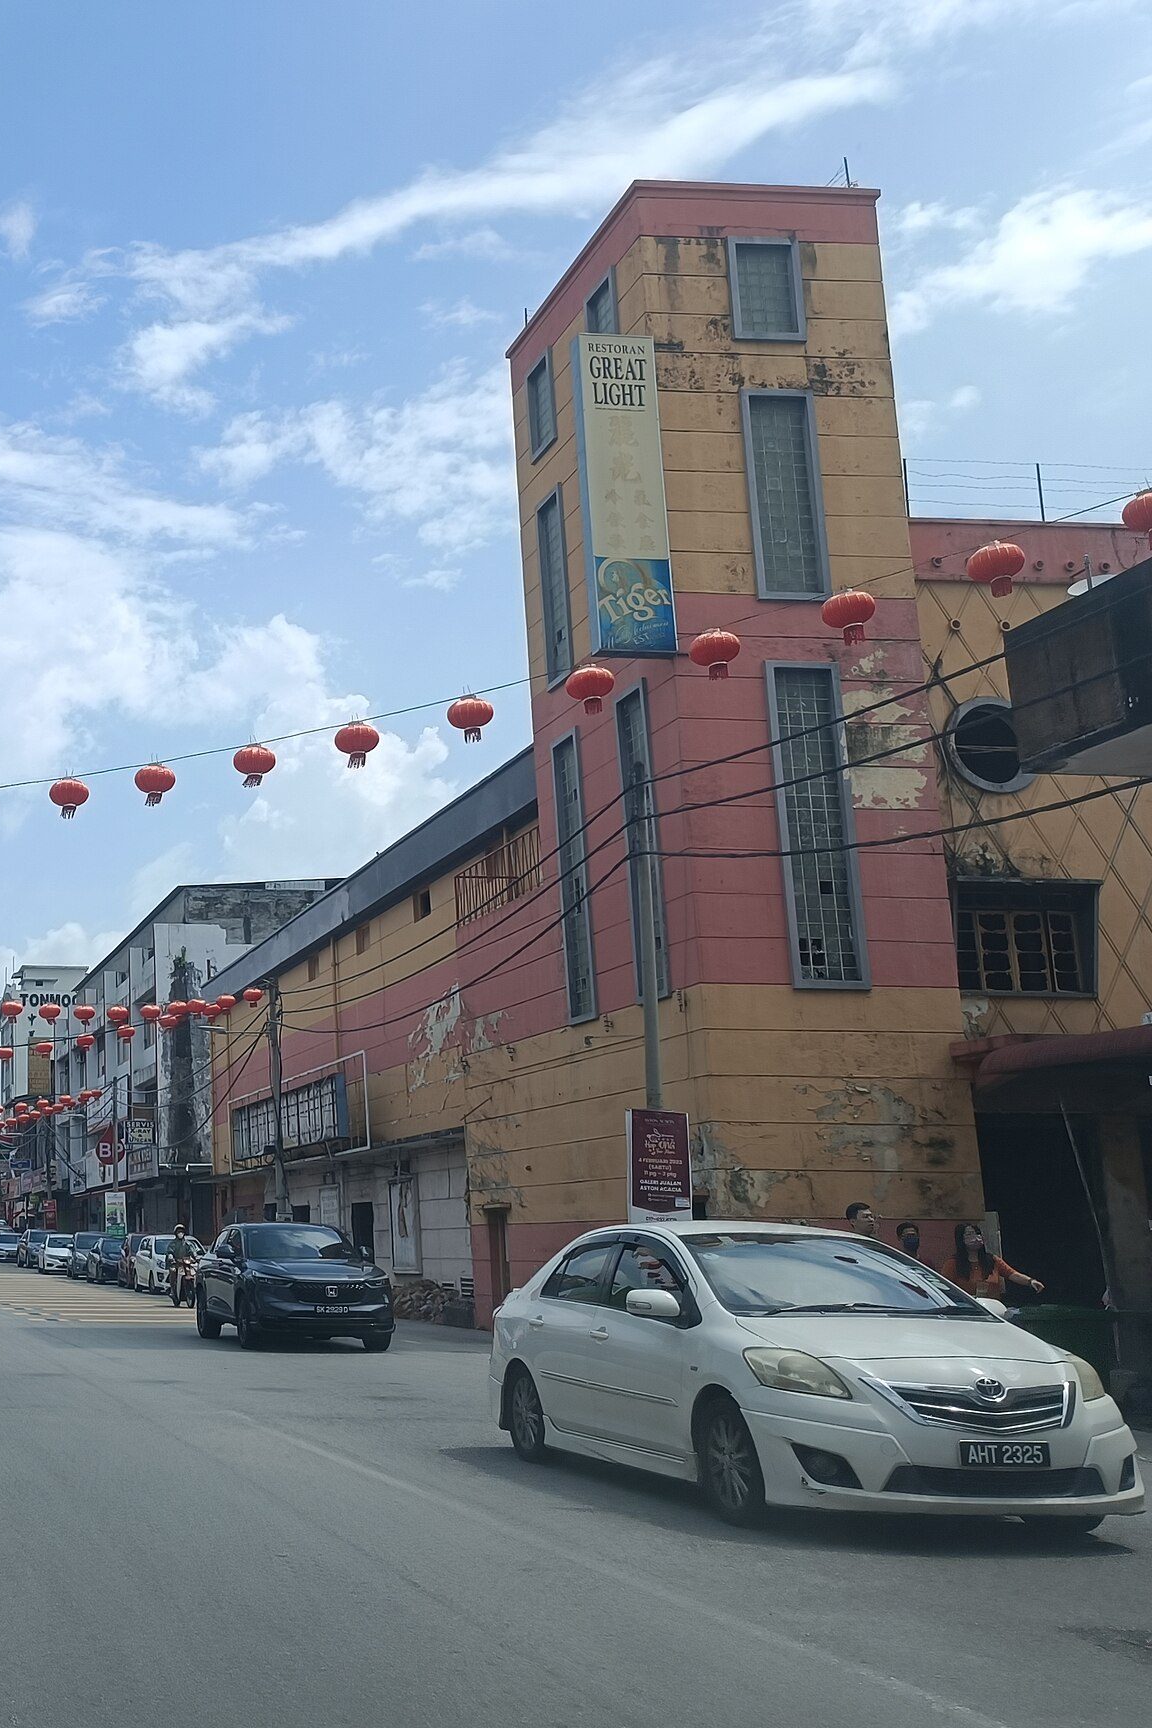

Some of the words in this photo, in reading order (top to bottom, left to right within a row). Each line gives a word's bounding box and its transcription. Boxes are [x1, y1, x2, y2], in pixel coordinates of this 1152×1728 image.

[588, 342, 645, 355] RESTORAN
[589, 355, 647, 381] GREAT
[592, 382, 646, 407] LIGHT
[599, 582, 671, 623] Tiger
[968, 1444, 998, 1464] AHT
[1002, 1445, 1044, 1464] 2325
